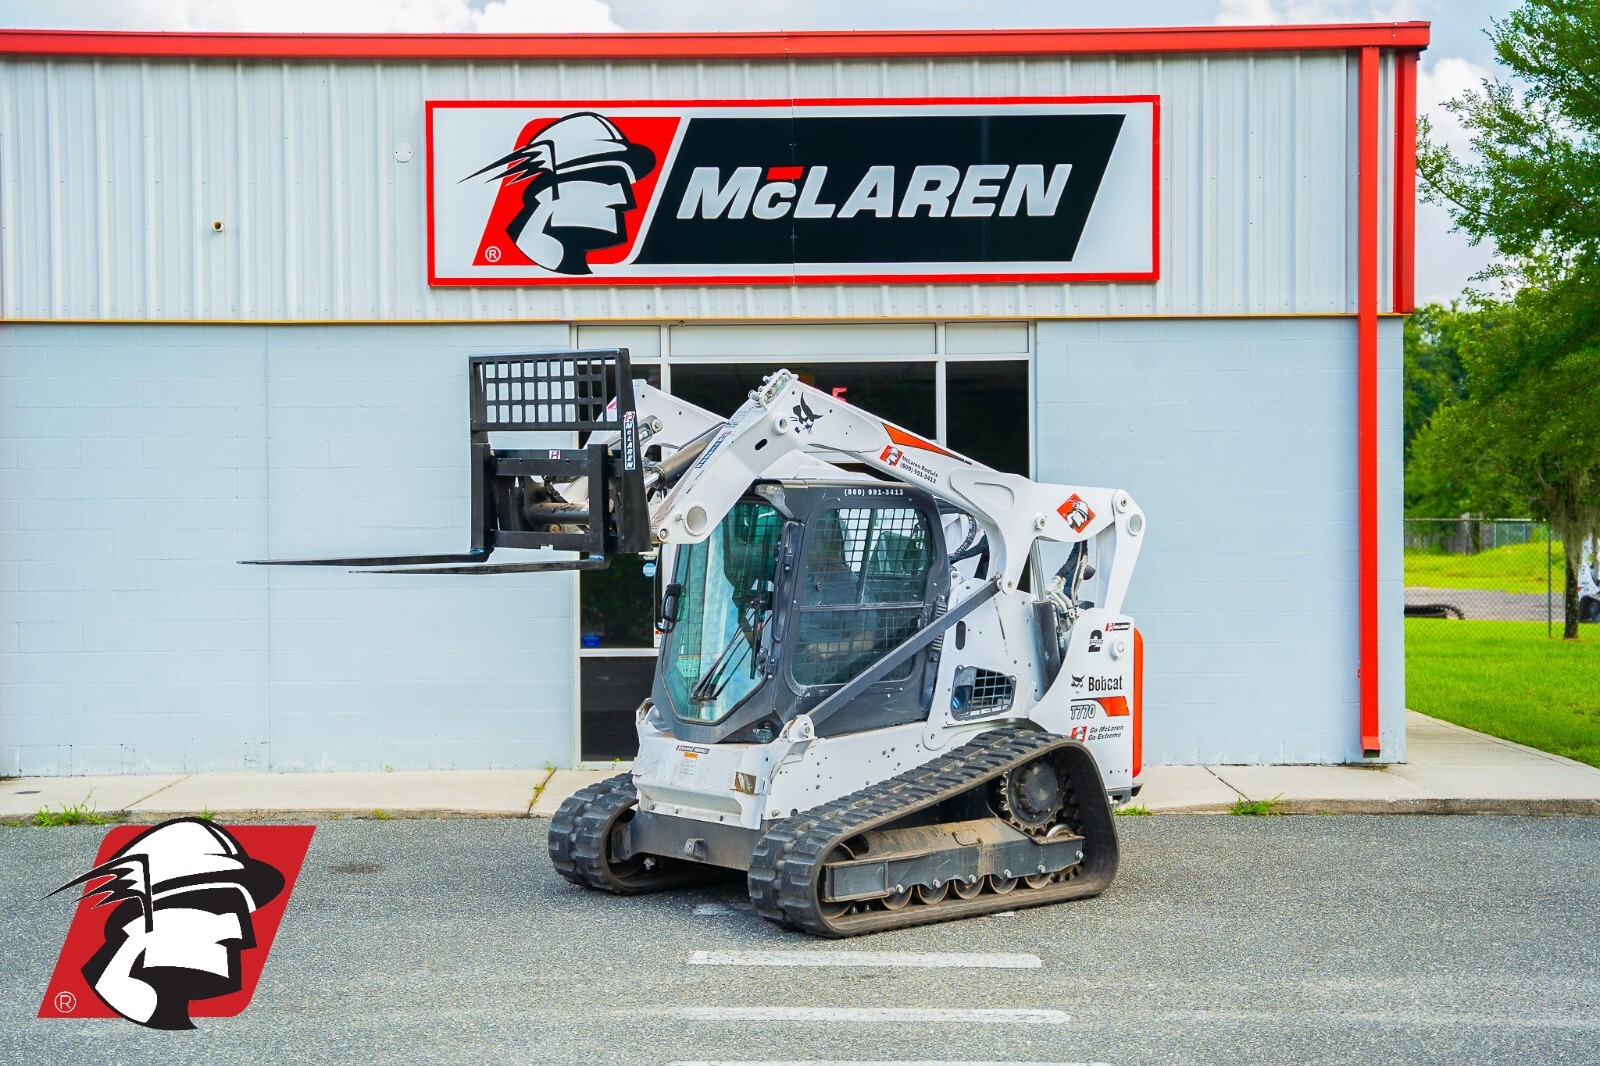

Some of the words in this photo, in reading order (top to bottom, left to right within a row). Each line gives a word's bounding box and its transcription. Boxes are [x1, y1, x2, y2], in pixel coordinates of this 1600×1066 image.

[676, 163, 1073, 221] McLAREN
[844, 488, 865, 497] (800)
[867, 488, 904, 496] 991-3413
[1087, 629, 1103, 653] 2
[1088, 675, 1123, 692] Bobcat
[1070, 703, 1096, 720] T770
[1089, 726, 1098, 734] Go
[1099, 725, 1124, 733] McLaren
[1097, 732, 1122, 740] Extreme
